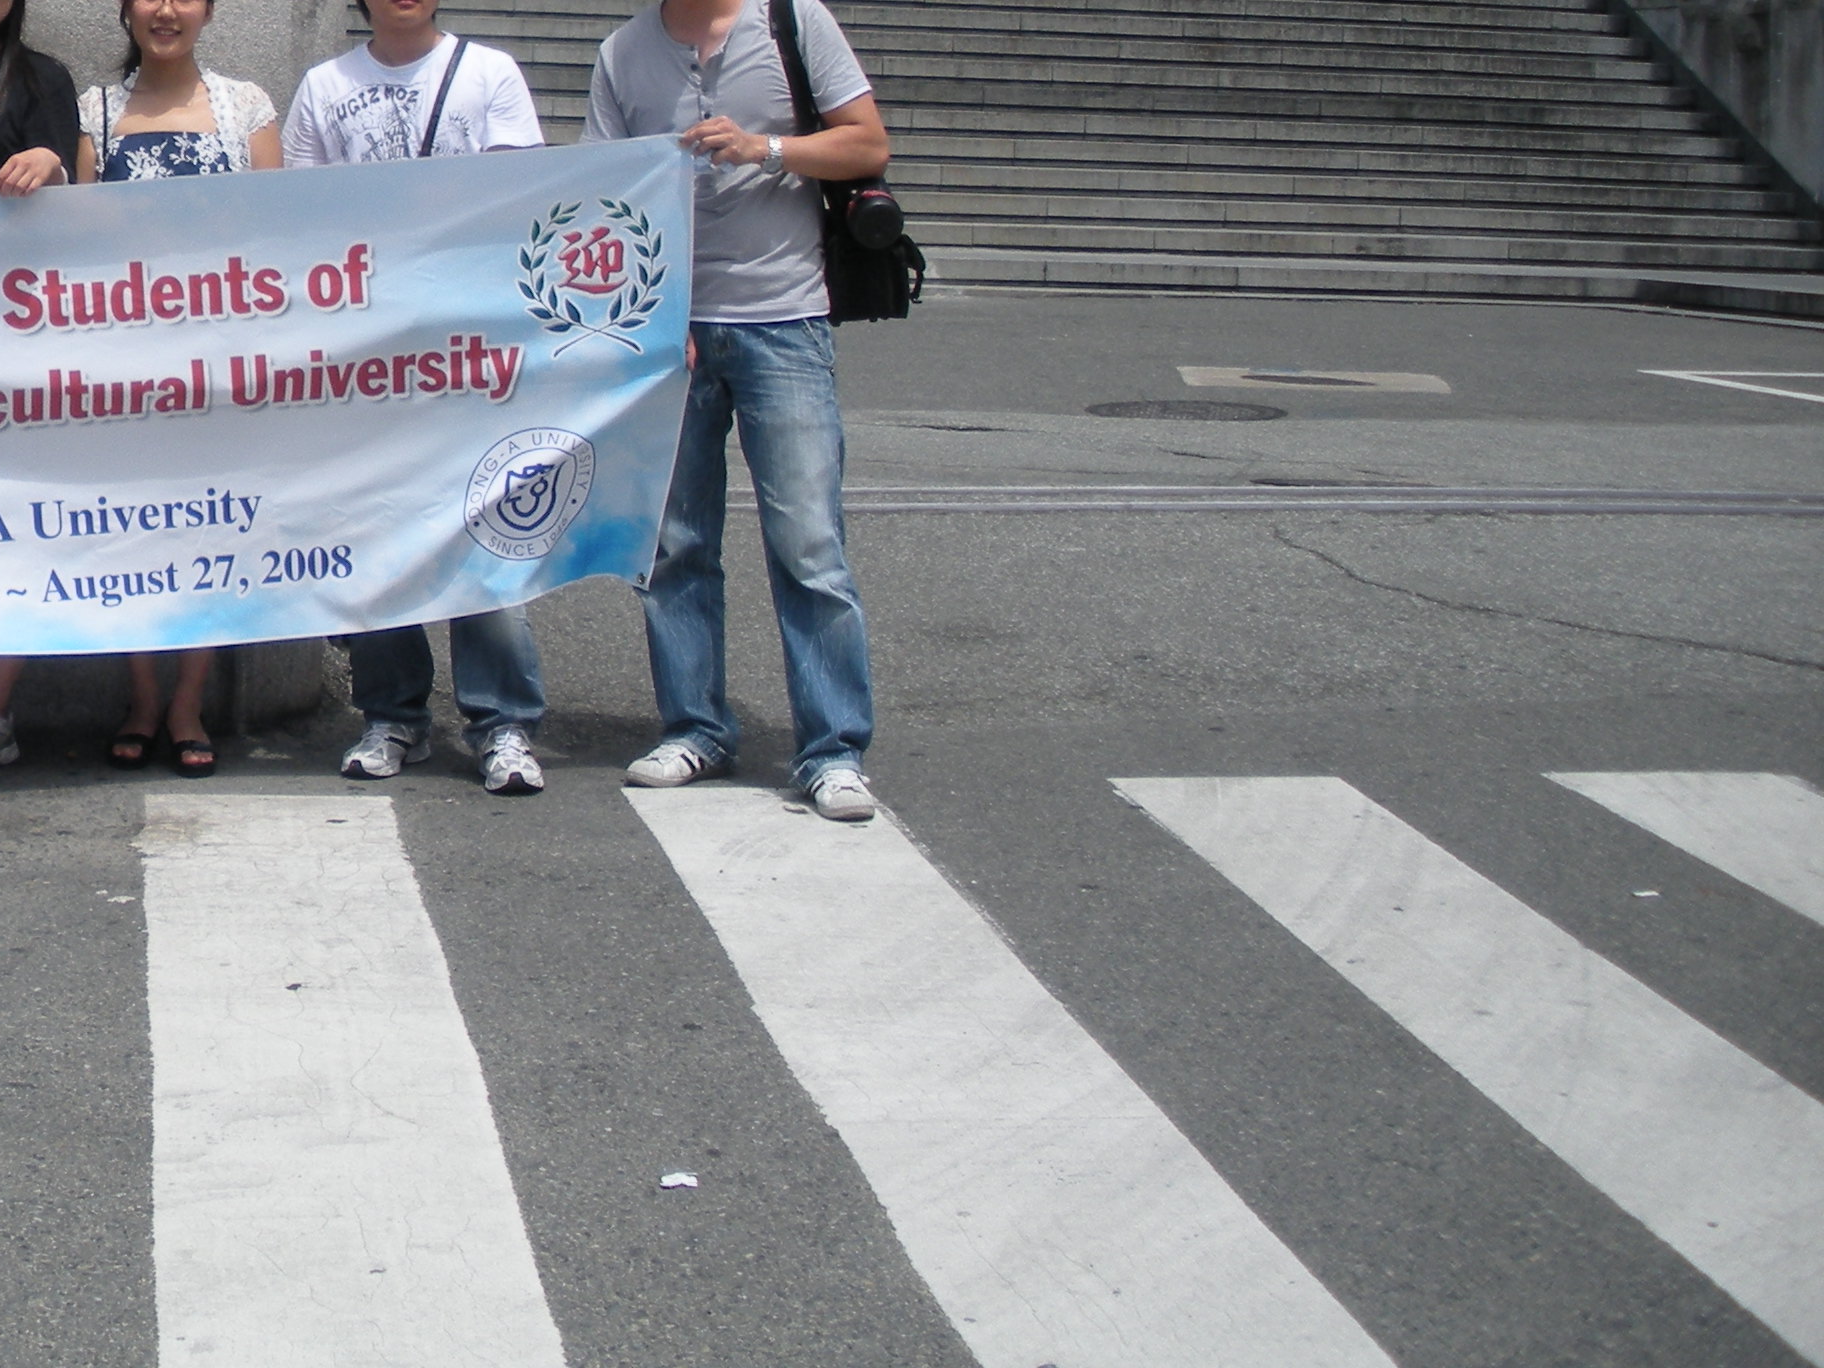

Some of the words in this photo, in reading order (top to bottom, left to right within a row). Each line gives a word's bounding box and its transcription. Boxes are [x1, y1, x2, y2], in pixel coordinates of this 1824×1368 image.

[2, 256, 285, 330] Students
[307, 243, 369, 308] of
[558, 226, 629, 294] 迎
[229, 336, 522, 406] University
[29, 487, 263, 540] University
[468, 440, 521, 519] DONG-A
[42, 561, 180, 608] August
[191, 554, 250, 595] 27,
[261, 544, 353, 585] 2008
[487, 535, 536, 557] SINCE
